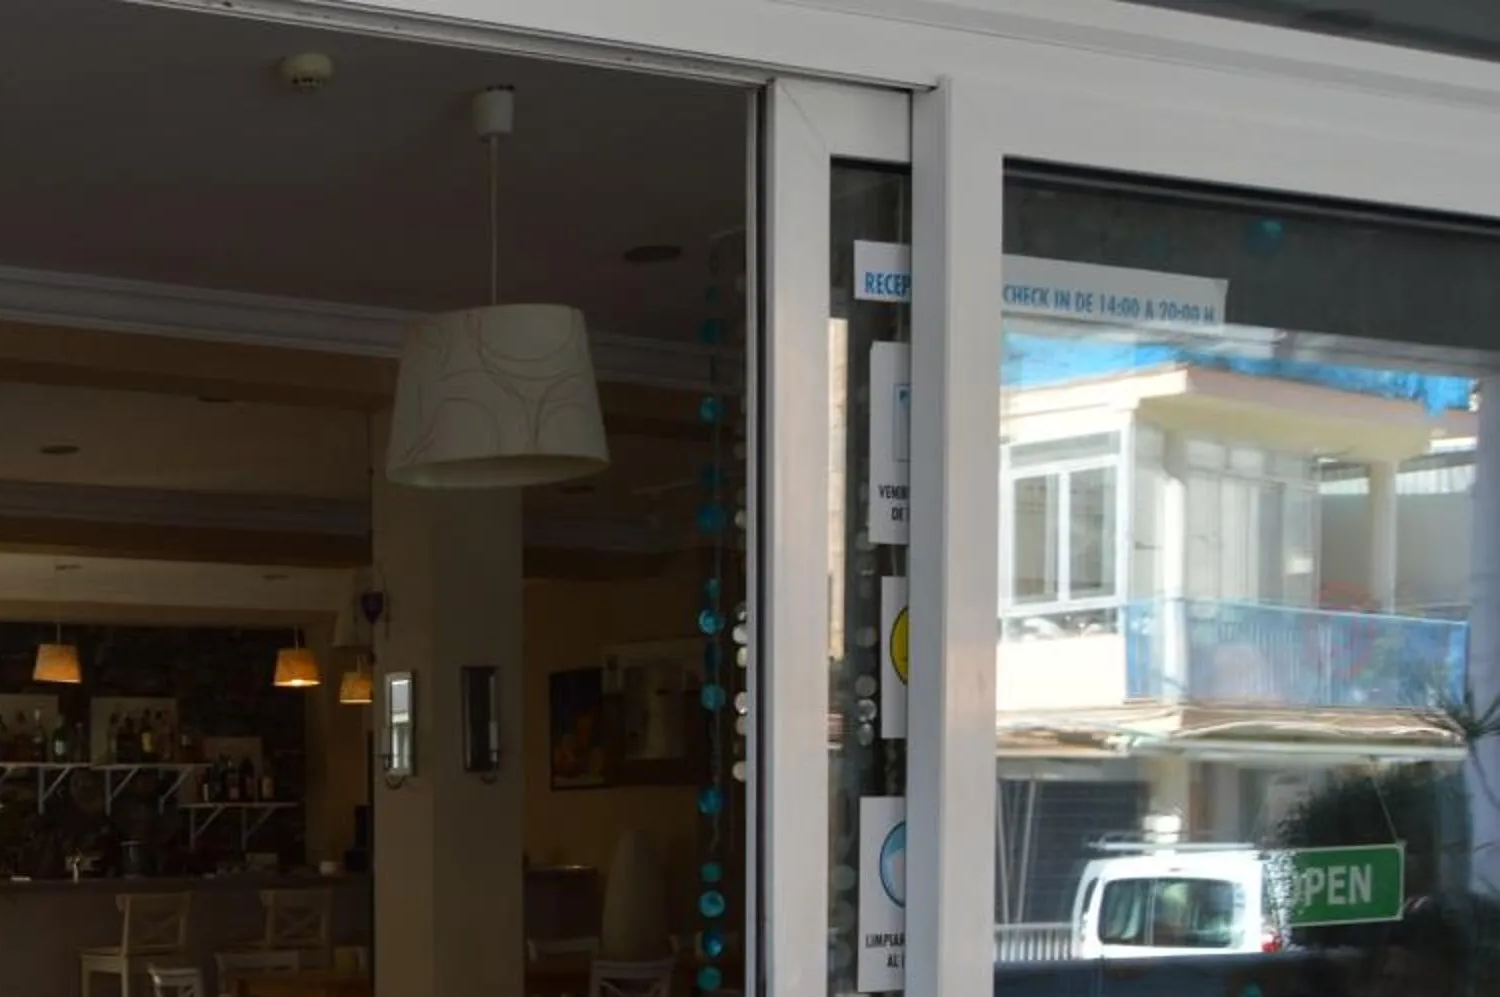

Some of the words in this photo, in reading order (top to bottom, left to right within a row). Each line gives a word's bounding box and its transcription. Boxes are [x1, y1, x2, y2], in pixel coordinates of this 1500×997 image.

[1002, 284, 1050, 308] CHECK
[1054, 288, 1071, 310] IN
[1075, 291, 1093, 313] DE
[1099, 294, 1140, 317] 14:00
[1145, 300, 1154, 320] A
[1159, 301, 1200, 323] 20:00
